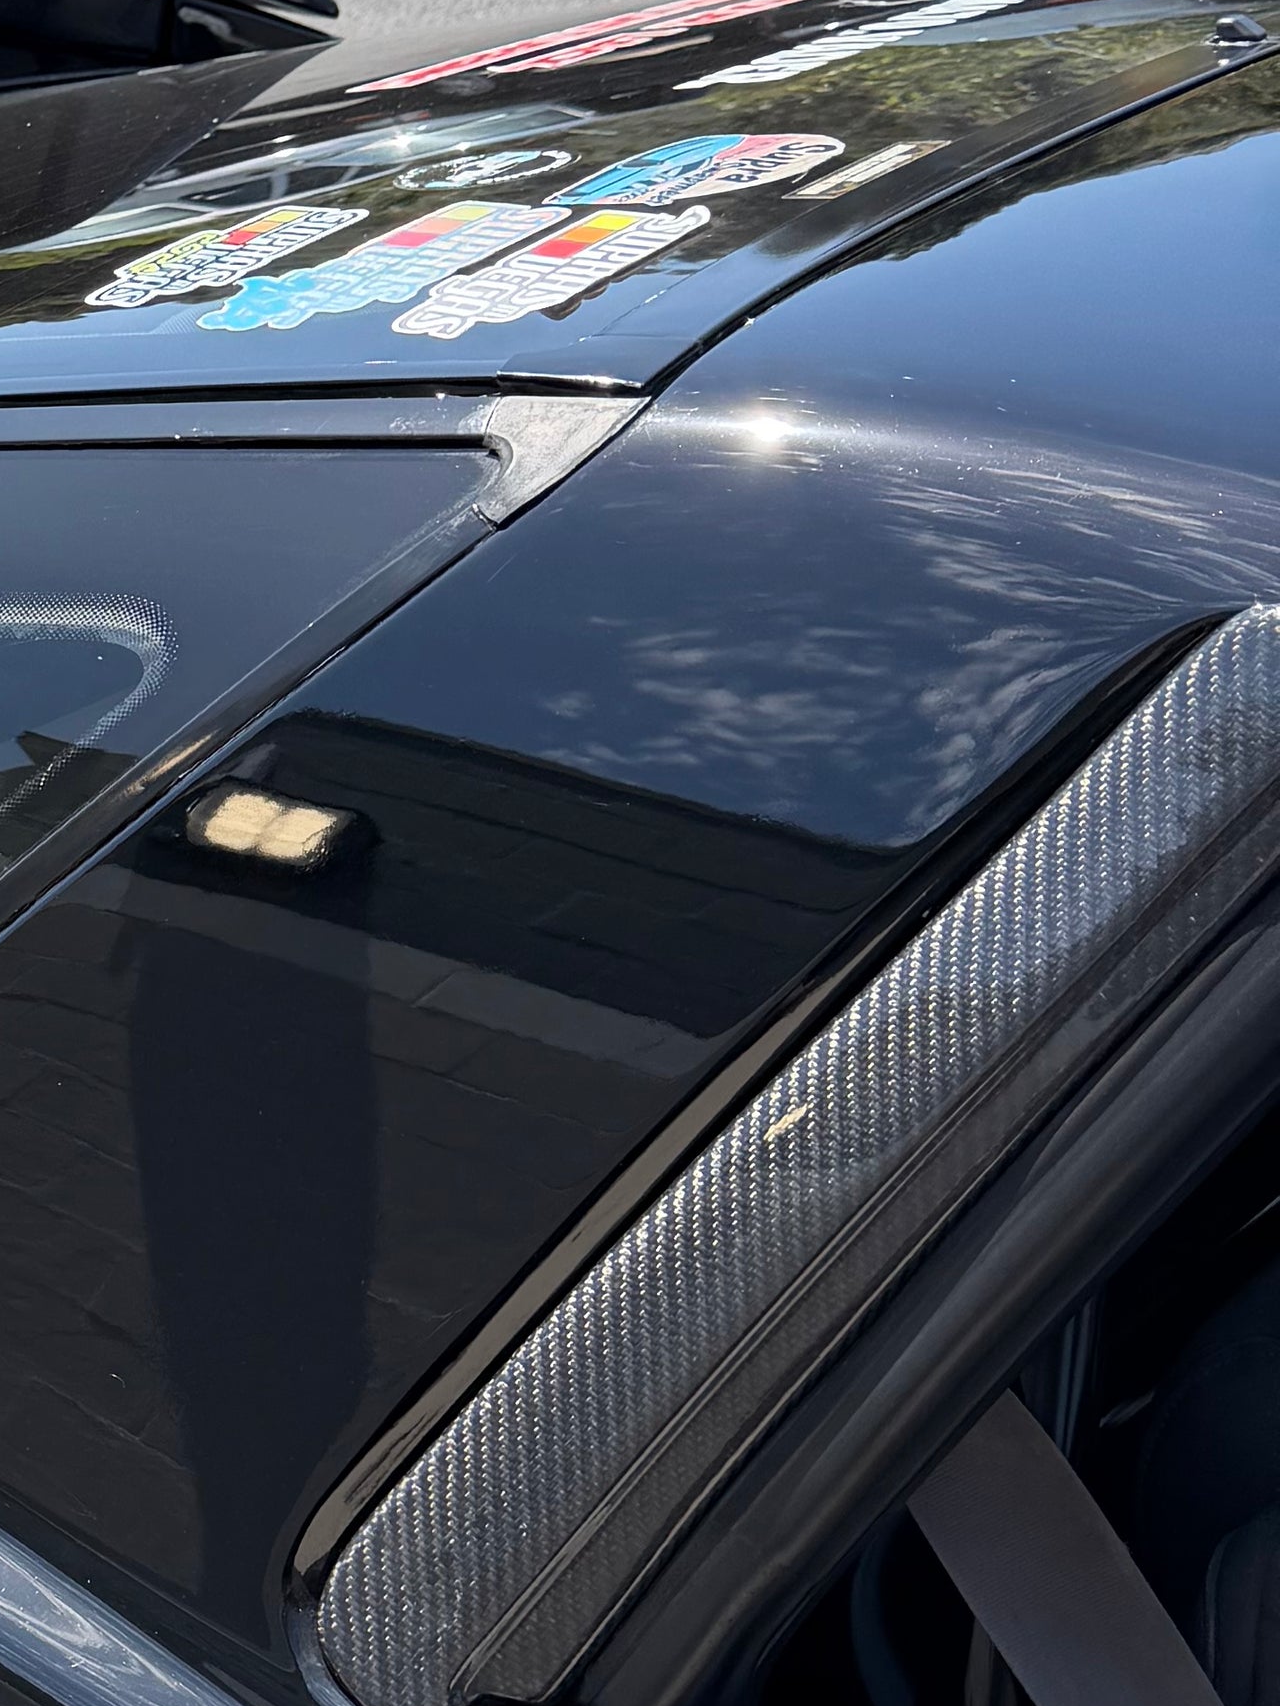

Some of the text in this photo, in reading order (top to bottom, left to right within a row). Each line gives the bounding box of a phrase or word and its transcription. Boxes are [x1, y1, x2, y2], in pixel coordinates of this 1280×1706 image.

[714, 141, 838, 184] Supra
[189, 212, 357, 283] SUPRAS
[508, 214, 696, 307] SUPRAS
